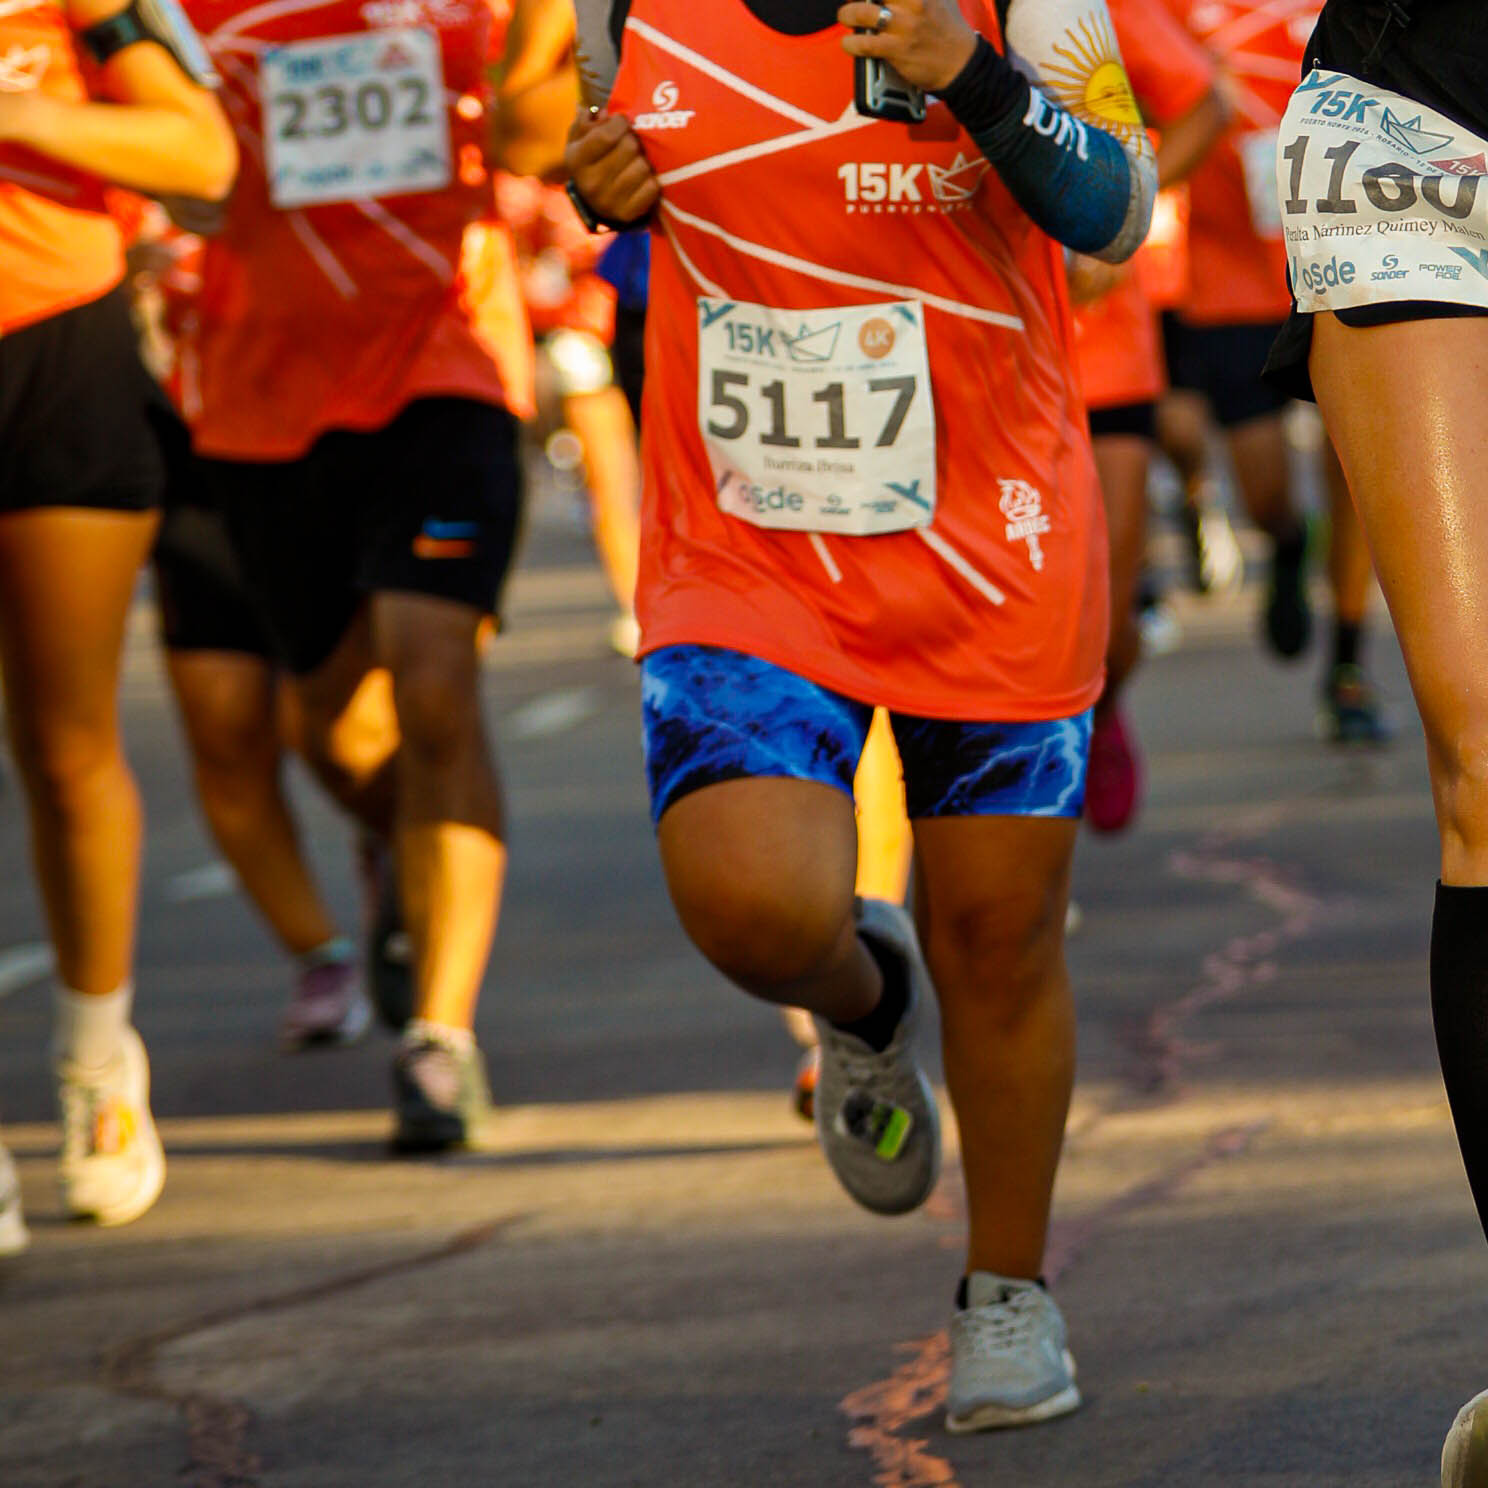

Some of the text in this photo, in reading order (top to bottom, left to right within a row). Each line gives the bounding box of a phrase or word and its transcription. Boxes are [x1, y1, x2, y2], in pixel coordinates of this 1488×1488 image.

[274, 77, 433, 141] 2302
[1310, 90, 1379, 123] 15K
[837, 163, 923, 202] 15K
[1377, 217, 1439, 236] Quimey
[1302, 255, 1356, 292] osde
[724, 322, 776, 357] 15K
[707, 368, 918, 449] 5117
